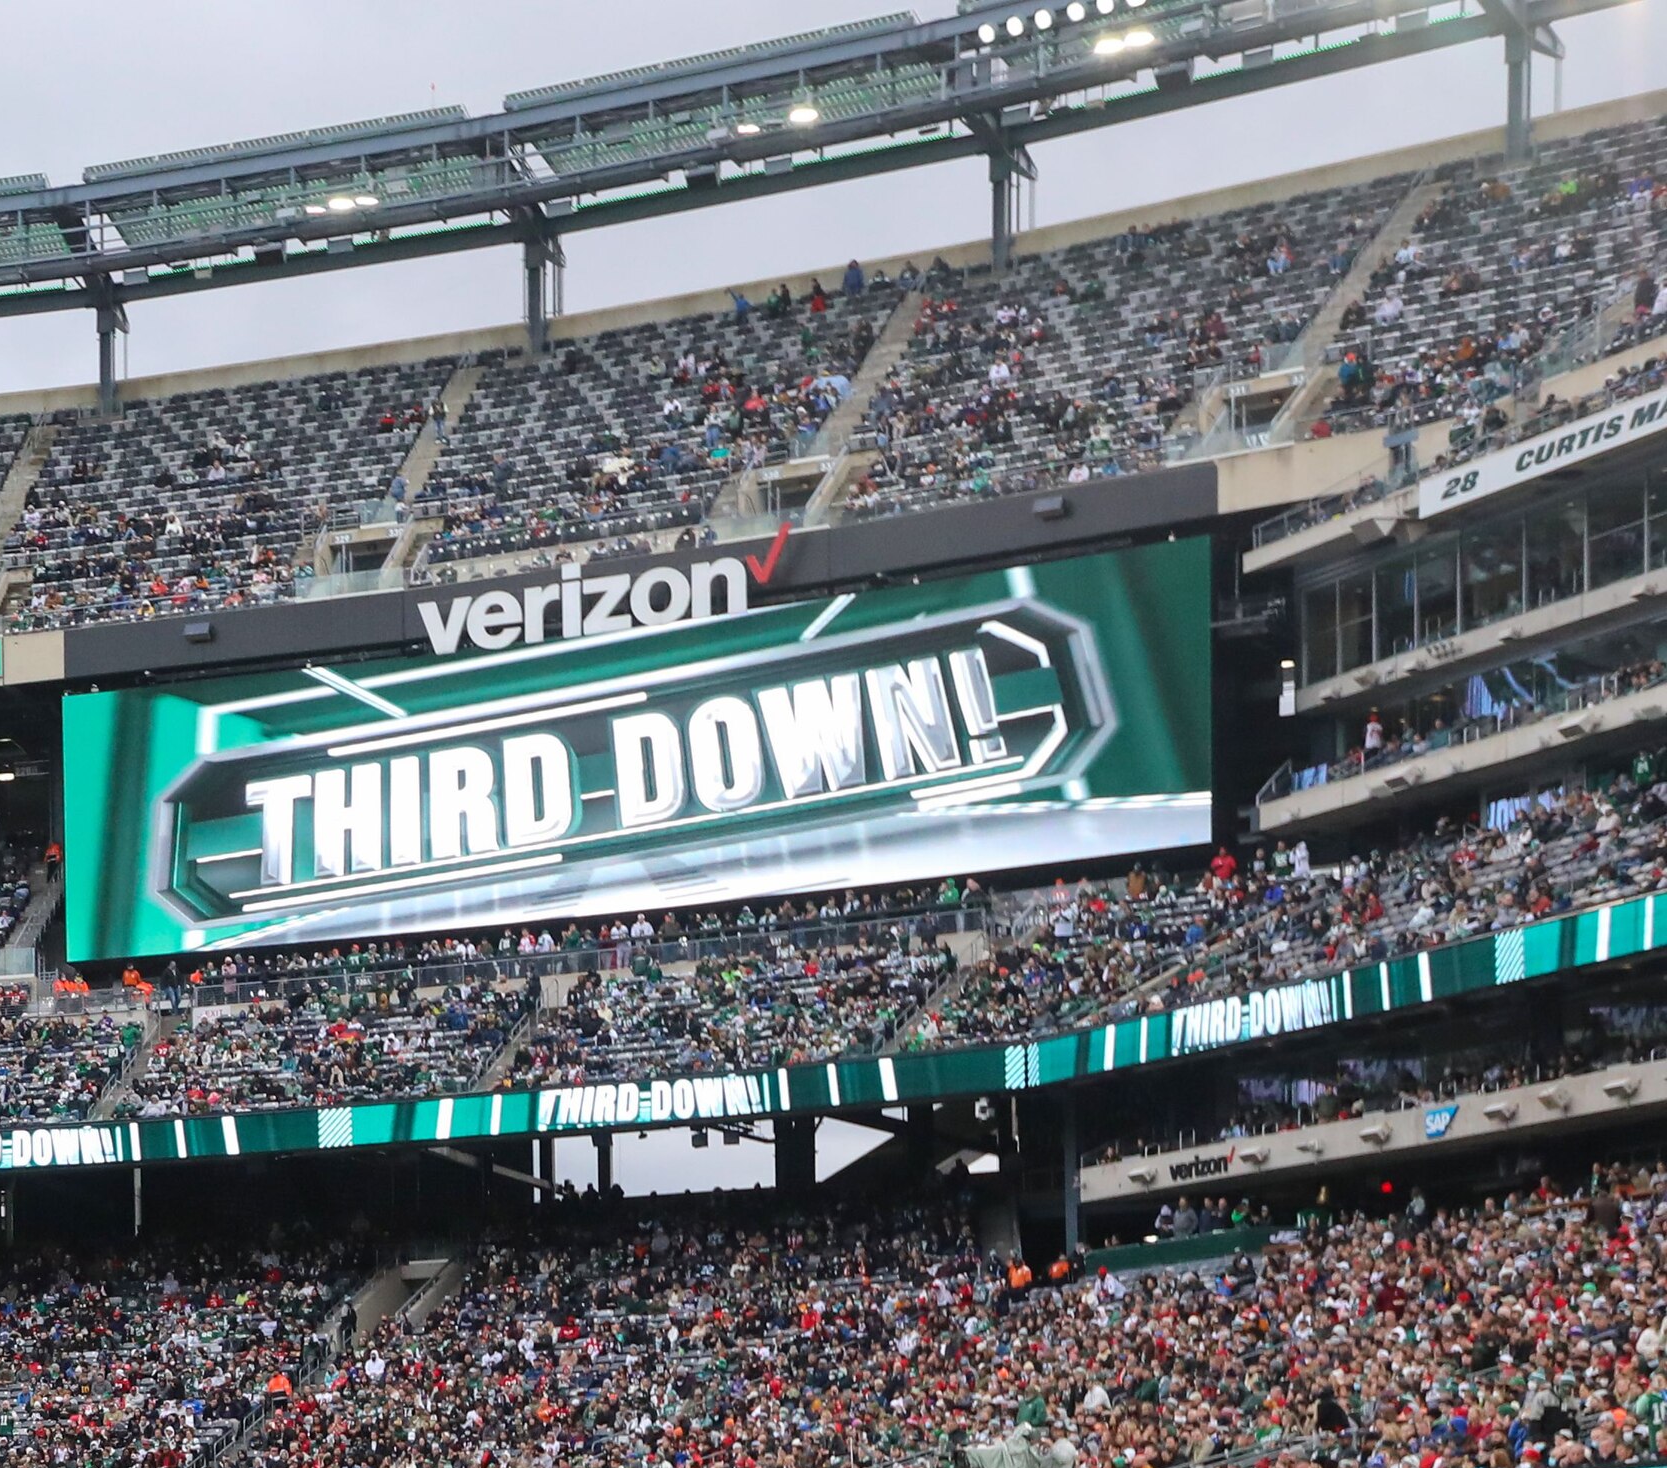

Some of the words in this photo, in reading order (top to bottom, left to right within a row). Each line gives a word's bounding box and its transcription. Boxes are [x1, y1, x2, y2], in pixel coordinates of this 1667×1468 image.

[1515, 414, 1625, 473] CURTIS
[1441, 470, 1480, 501] 28
[418, 558, 749, 656] verizon
[245, 729, 575, 886] THIRD
[614, 647, 1012, 831] DOWN!
[1170, 995, 1242, 1056] THIRD
[536, 1082, 640, 1128] THIRD
[1426, 1111, 1451, 1131] SAP
[1169, 1157, 1229, 1182] verizon
